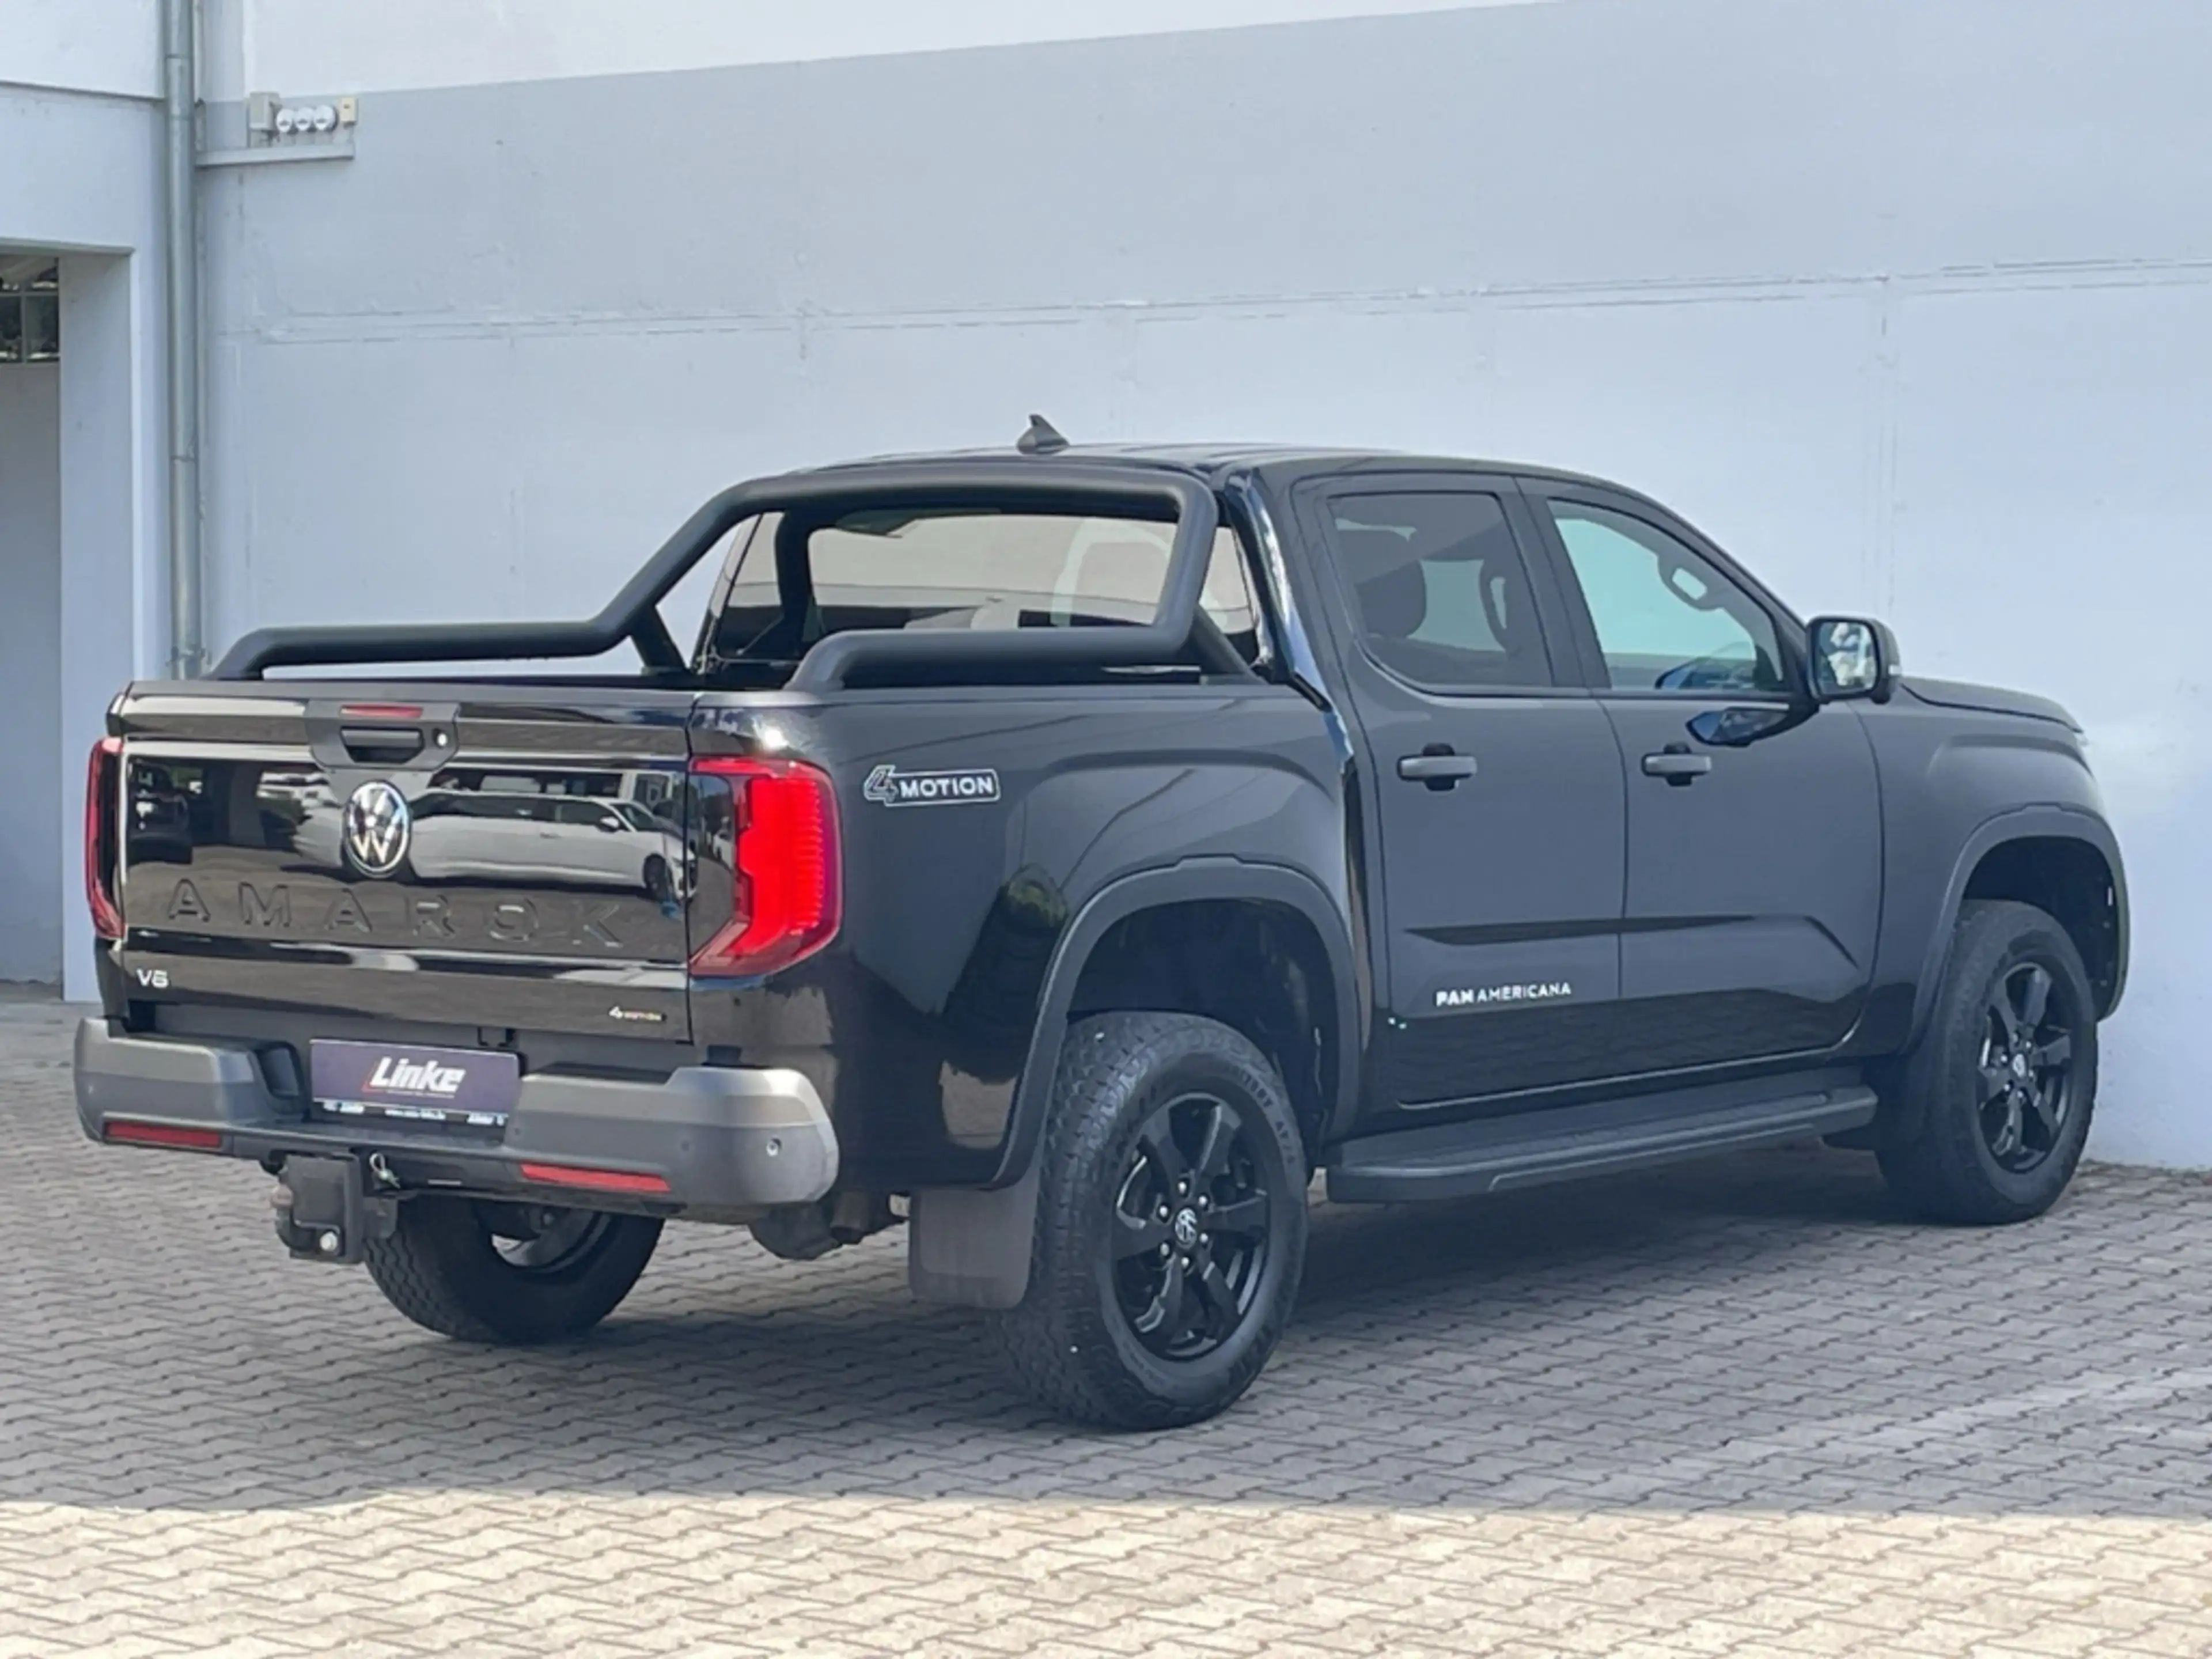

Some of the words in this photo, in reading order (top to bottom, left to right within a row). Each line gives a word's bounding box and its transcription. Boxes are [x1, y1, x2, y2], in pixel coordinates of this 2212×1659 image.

[167, 878, 623, 948] AMAROK
[137, 969, 169, 988] V6
[370, 1057, 465, 1092] Linke
